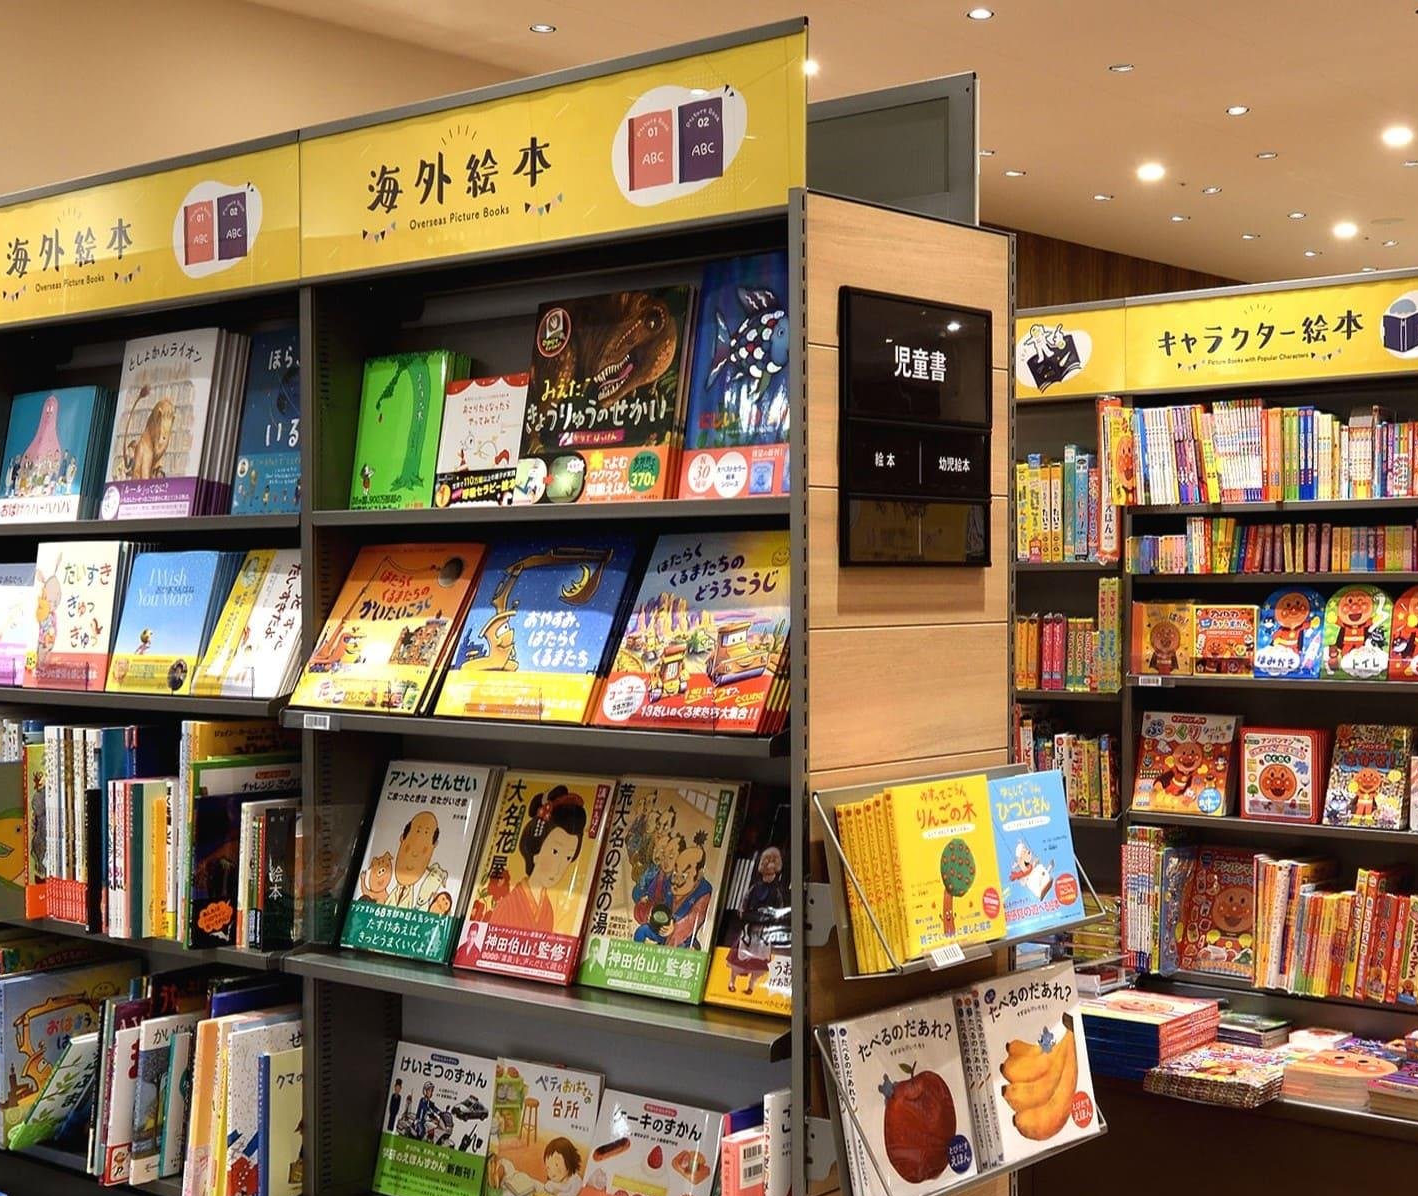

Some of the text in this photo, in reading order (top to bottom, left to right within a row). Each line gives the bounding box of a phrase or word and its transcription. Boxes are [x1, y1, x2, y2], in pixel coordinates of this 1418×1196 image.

[647, 126, 659, 139] 01
[697, 117, 710, 129] 02
[642, 151, 664, 166] ABC
[691, 142, 715, 158] ABC
[366, 136, 552, 215] 海外絵本
[409, 204, 510, 231] Overseas Picture Books
[6, 218, 133, 279] 海外絵本
[35, 273, 105, 293] Overseas Picture Books
[1157, 309, 1364, 357] キャラクター絵本
[129, 342, 202, 371] としょかんライオン
[894, 345, 947, 383] 児童書
[1257, 352, 1277, 363] Popular
[1278, 350, 1310, 361] Characters
[526, 399, 668, 434] きょうりゅうのせかい
[874, 451, 971, 473] 絵本 幼児絵本
[63, 561, 113, 588] だいすき
[656, 542, 703, 575] はたらく
[668, 554, 746, 588] くるまたちの
[694, 569, 780, 602] どうろこうじ
[66, 594, 97, 618] ぎゅっ
[527, 630, 577, 647] はたらく
[530, 649, 589, 668] くるまたち
[1351, 656, 1381, 670] トイレ
[387, 771, 477, 794] アントンせんせい
[914, 798, 980, 835] りんごの木
[994, 792, 1053, 824] ひつじさん
[489, 781, 528, 881] 大名花屋
[590, 782, 636, 937] 荒大名の茶の湯
[268, 864, 284, 901] 絵本
[987, 980, 1074, 1025] たべるのだあれ?
[856, 1022, 953, 1064] たべるのだあれ?
[959, 1019, 974, 1083] たべるのだあれ?
[968, 1018, 983, 1083] たべるのだあれ?
[975, 1010, 990, 1073] たべるのだあれ?
[399, 1055, 488, 1090] けいさつのずかん
[551, 1094, 581, 1120] 台所
